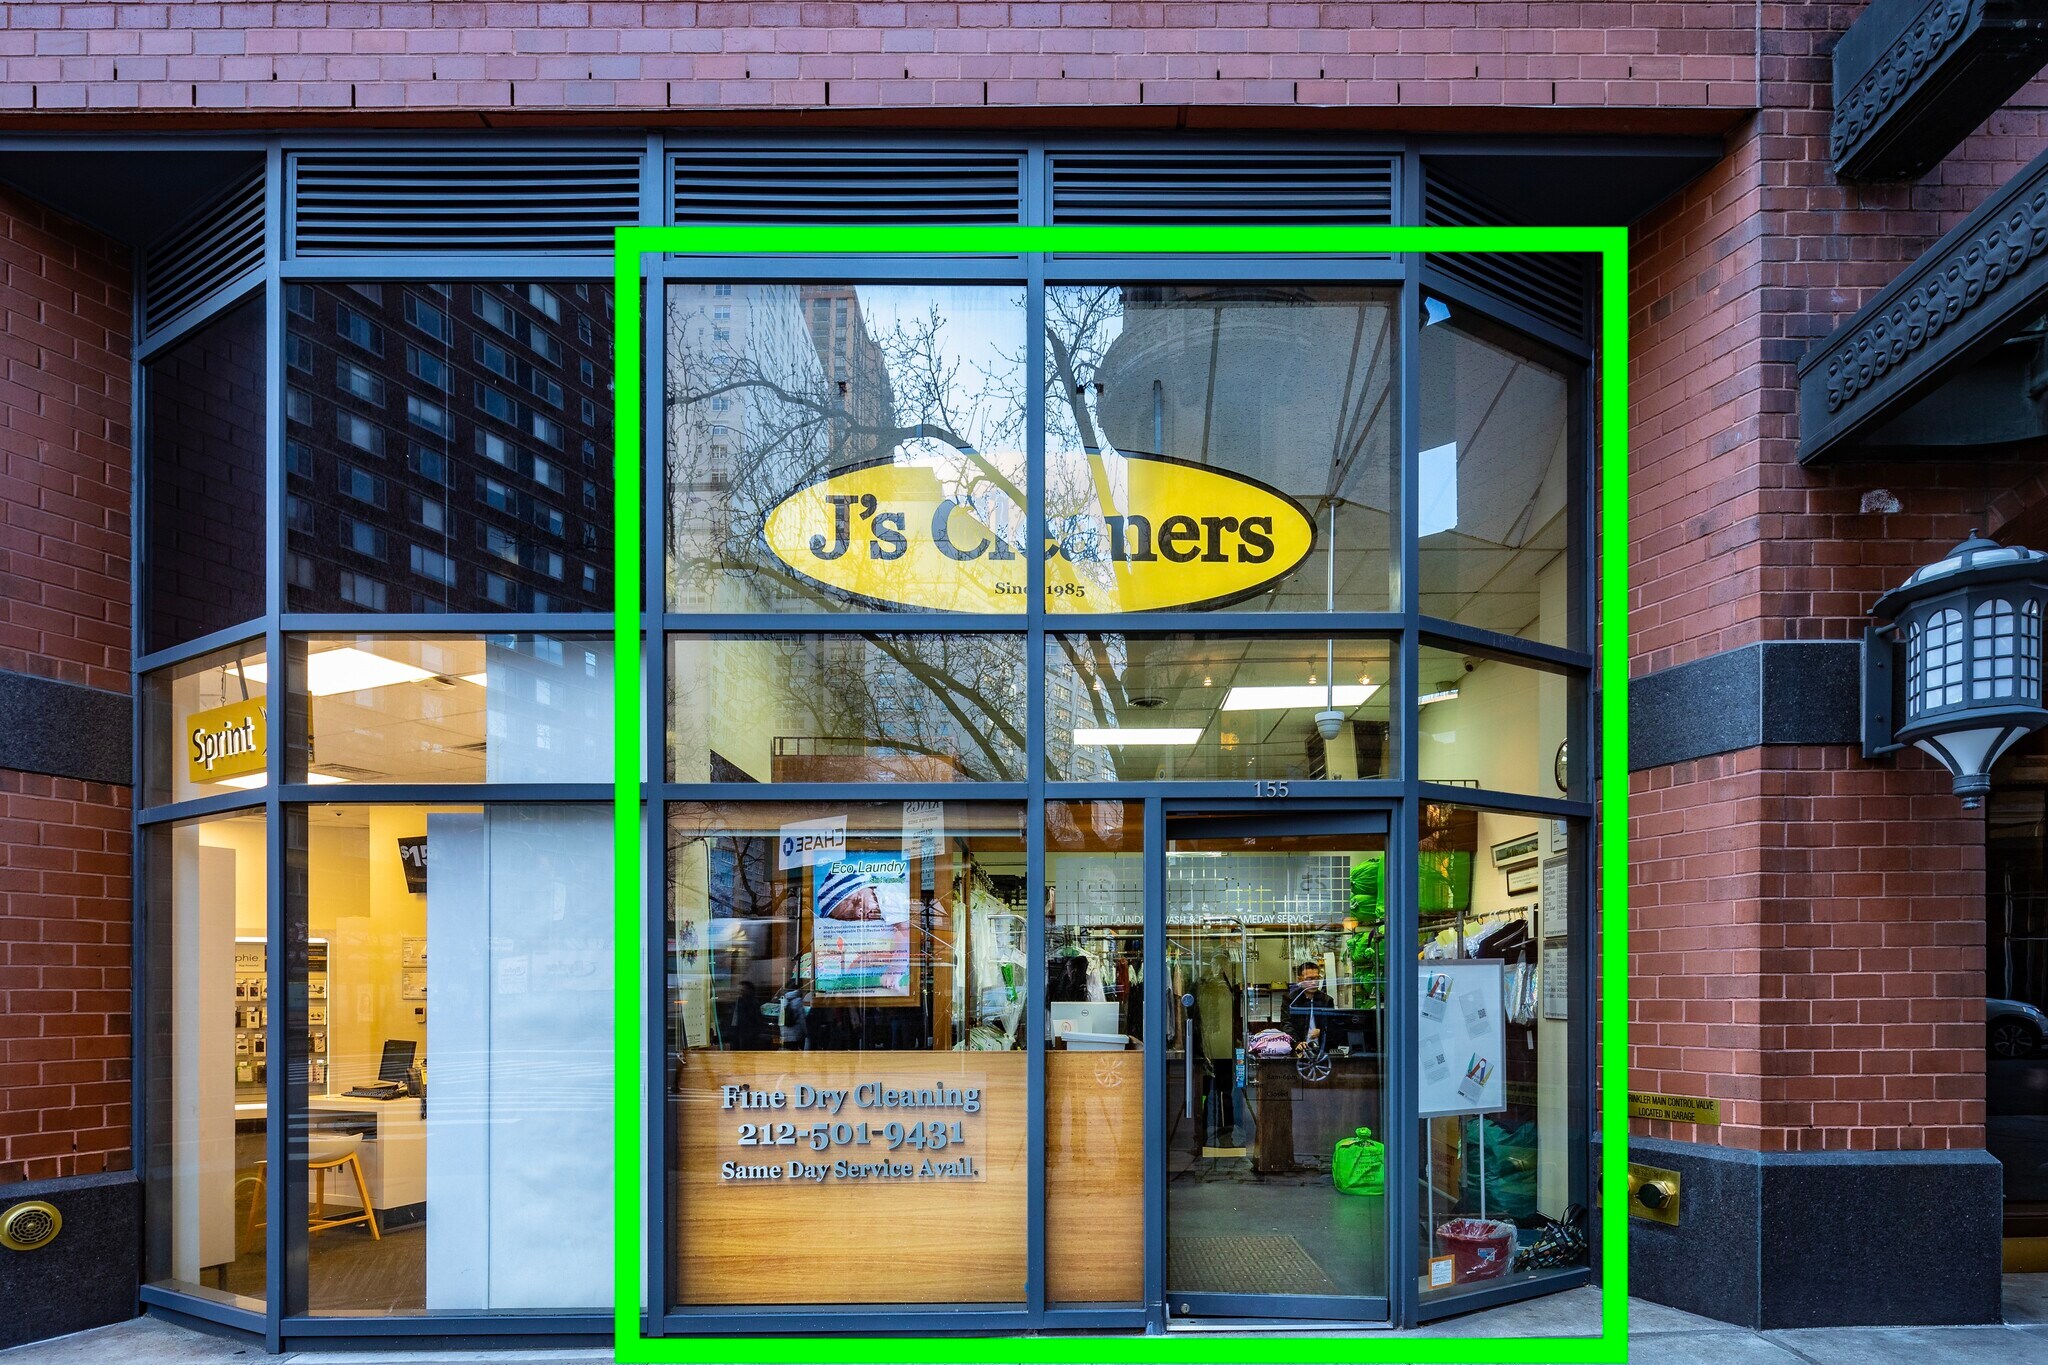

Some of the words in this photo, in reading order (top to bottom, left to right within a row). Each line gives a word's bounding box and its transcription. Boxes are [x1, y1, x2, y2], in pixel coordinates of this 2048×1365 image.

[809, 493, 908, 561] J's
[994, 581, 1028, 596] Sinc
[1046, 583, 1085, 598] 1985
[191, 714, 257, 771] Sprint
[1253, 781, 1290, 798] 155
[830, 860, 855, 875] Eco
[857, 859, 907, 876] Laundry
[1084, 914, 1110, 925] SHIRT
[1111, 914, 1144, 925] LAUND
[1188, 914, 1199, 925] &
[1277, 913, 1314, 924] SERVICE
[234, 953, 259, 963] phie
[720, 1083, 786, 1110] Fine
[793, 1082, 848, 1115] Dry
[852, 1080, 982, 1113] Cleaning
[1628, 1093, 1651, 1104] RINKLER
[1651, 1095, 1667, 1106] MAIN
[1667, 1097, 1695, 1109] CONTROL
[1695, 1099, 1714, 1111] VALVE
[1638, 1107, 1664, 1118] LOCATED
[1664, 1108, 1671, 1119] IN
[1671, 1110, 1696, 1122] GARAGE
[736, 1120, 964, 1151] 212-501-9431
[720, 1161, 782, 1181] Same
[786, 1160, 830, 1183] Day
[833, 1158, 913, 1179] Service
[918, 1157, 980, 1178] Avail.
